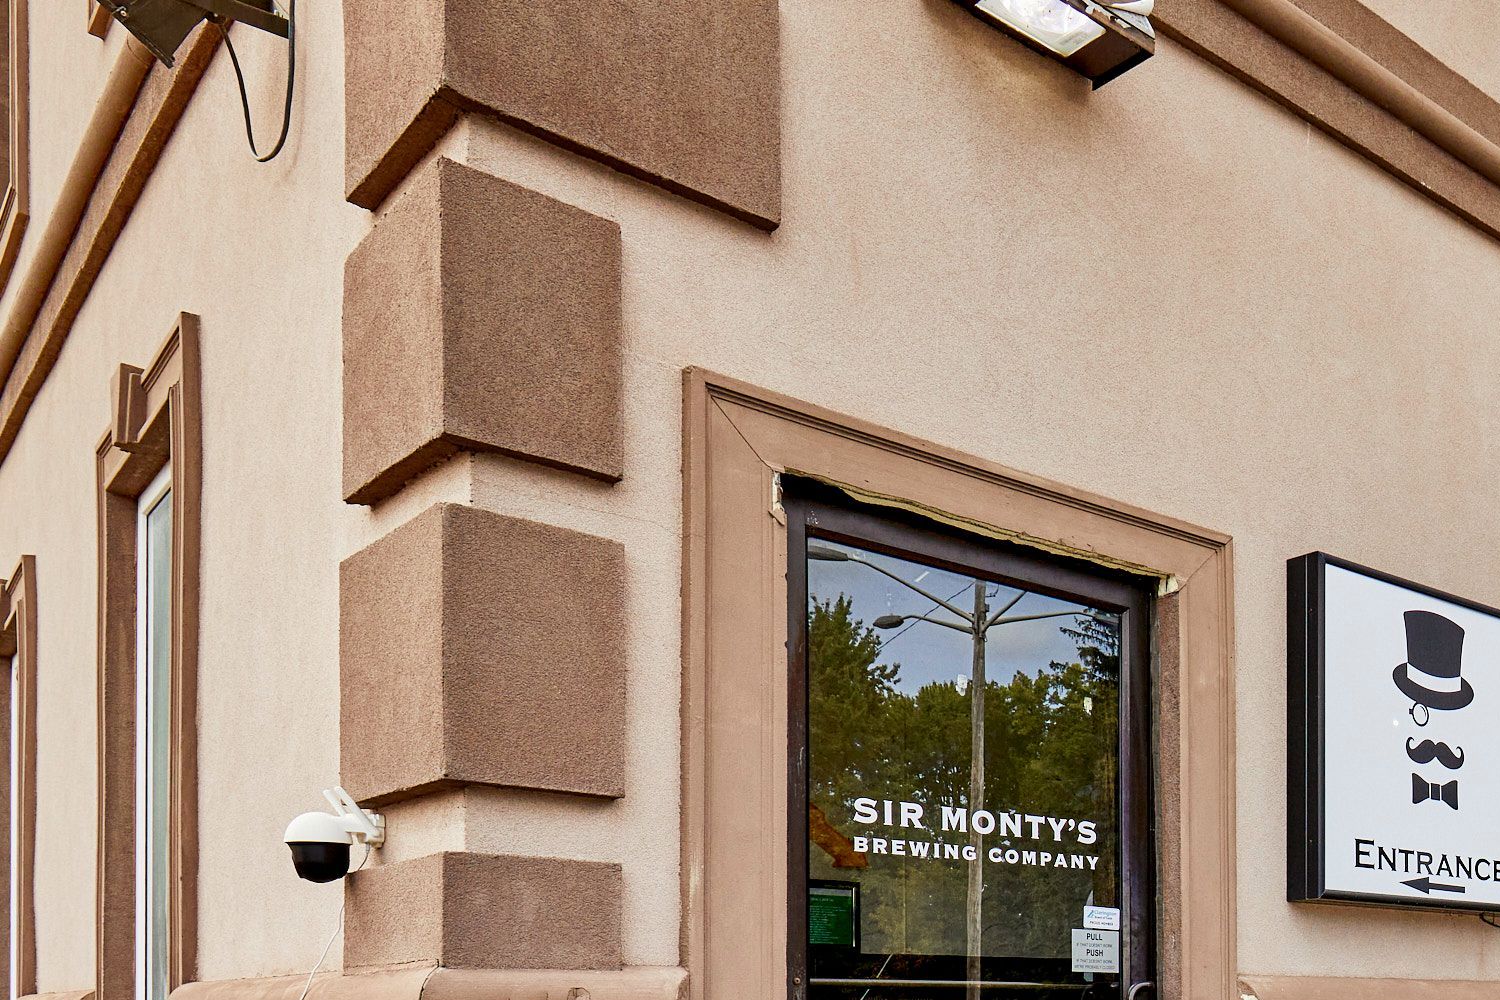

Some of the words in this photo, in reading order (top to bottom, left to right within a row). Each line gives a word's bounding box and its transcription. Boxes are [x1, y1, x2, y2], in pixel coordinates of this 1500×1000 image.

[853, 797, 924, 829] SIR
[941, 805, 1097, 845] MONTY'S
[853, 836, 977, 861] BREWING
[988, 847, 1099, 871] COMPANY
